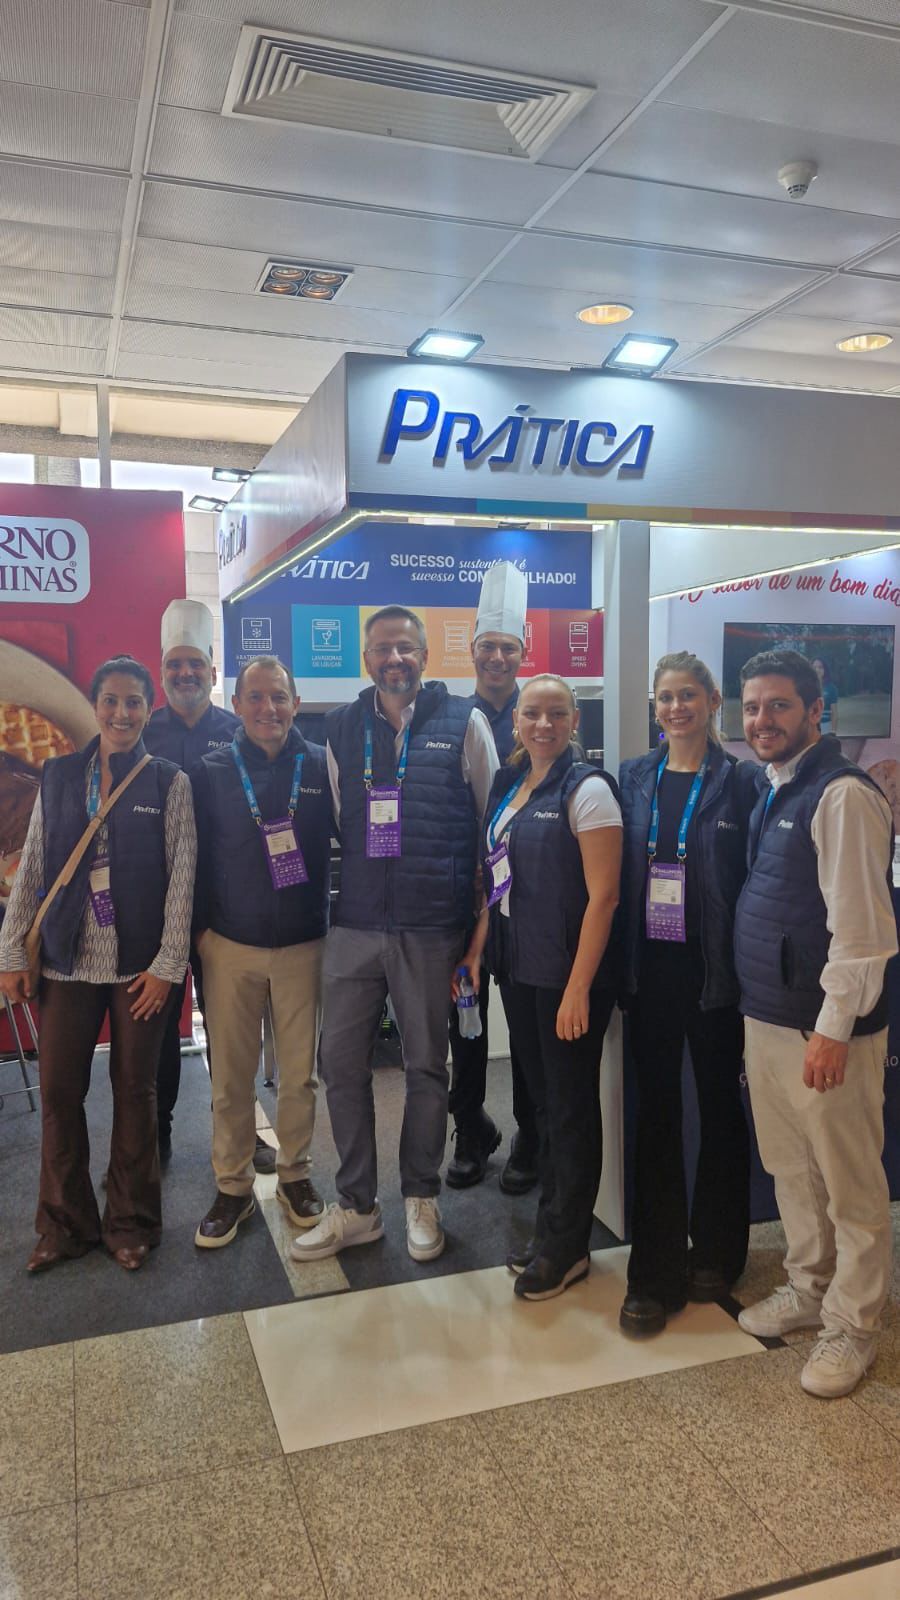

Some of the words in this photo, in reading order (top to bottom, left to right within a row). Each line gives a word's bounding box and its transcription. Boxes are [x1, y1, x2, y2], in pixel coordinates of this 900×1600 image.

[382, 388, 654, 472] PRÁTICA
[279, 555, 370, 580] ÁTICA
[390, 553, 455, 568] SUCESSO
[458, 559, 518, 570] sustentl
[411, 572, 454, 582] sucesso
[458, 569, 577, 585] COLHADO!
[768, 573, 792, 591] de
[796, 574, 825, 592] um
[829, 569, 869, 596] bom
